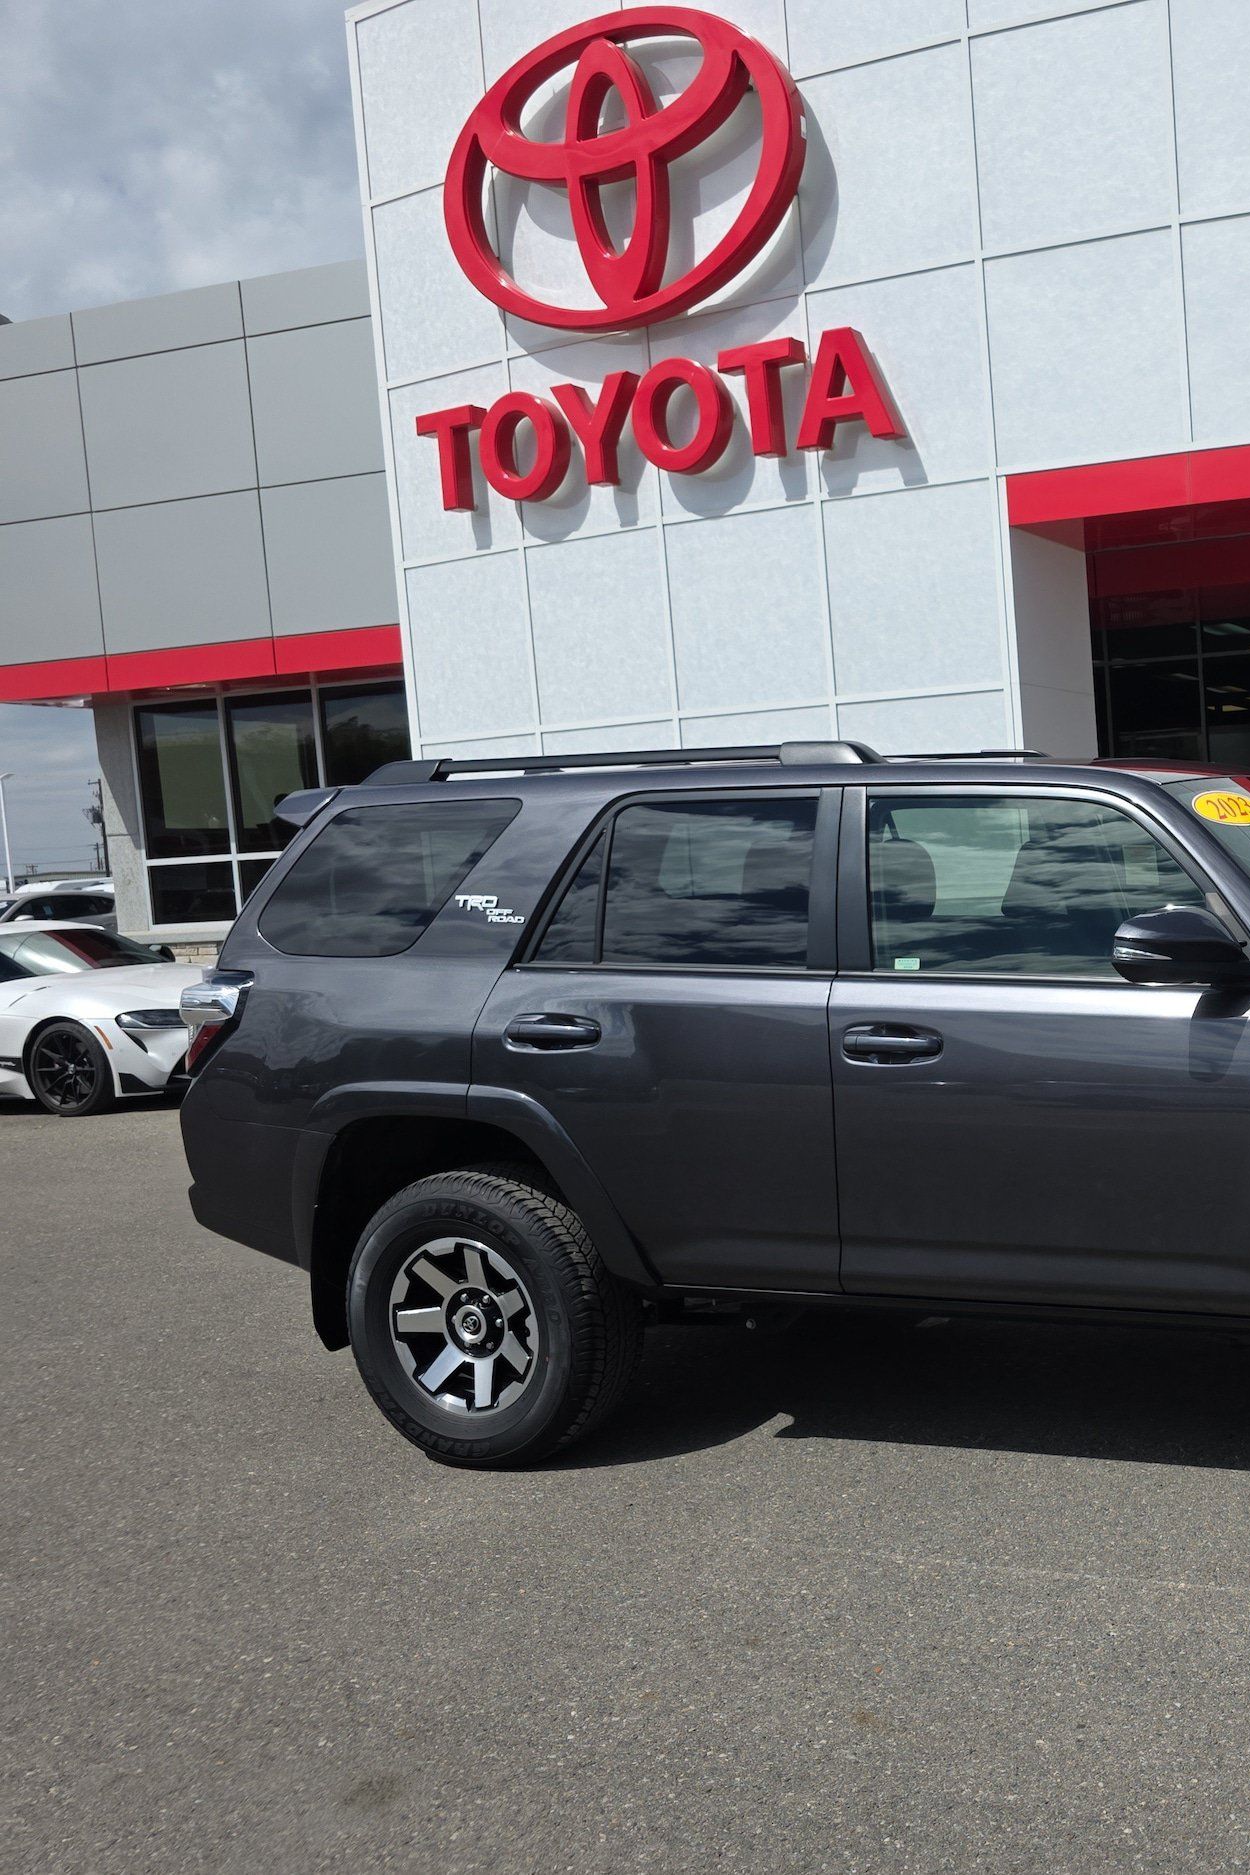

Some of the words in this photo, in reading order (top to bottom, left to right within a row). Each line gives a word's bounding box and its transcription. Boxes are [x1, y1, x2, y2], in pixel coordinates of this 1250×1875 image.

[415, 326, 906, 512] TOYOTA
[454, 894, 499, 911] TRD
[486, 908, 514, 916] OFF
[487, 915, 526, 924] ROAD
[422, 1201, 521, 1247] DUNLOP
